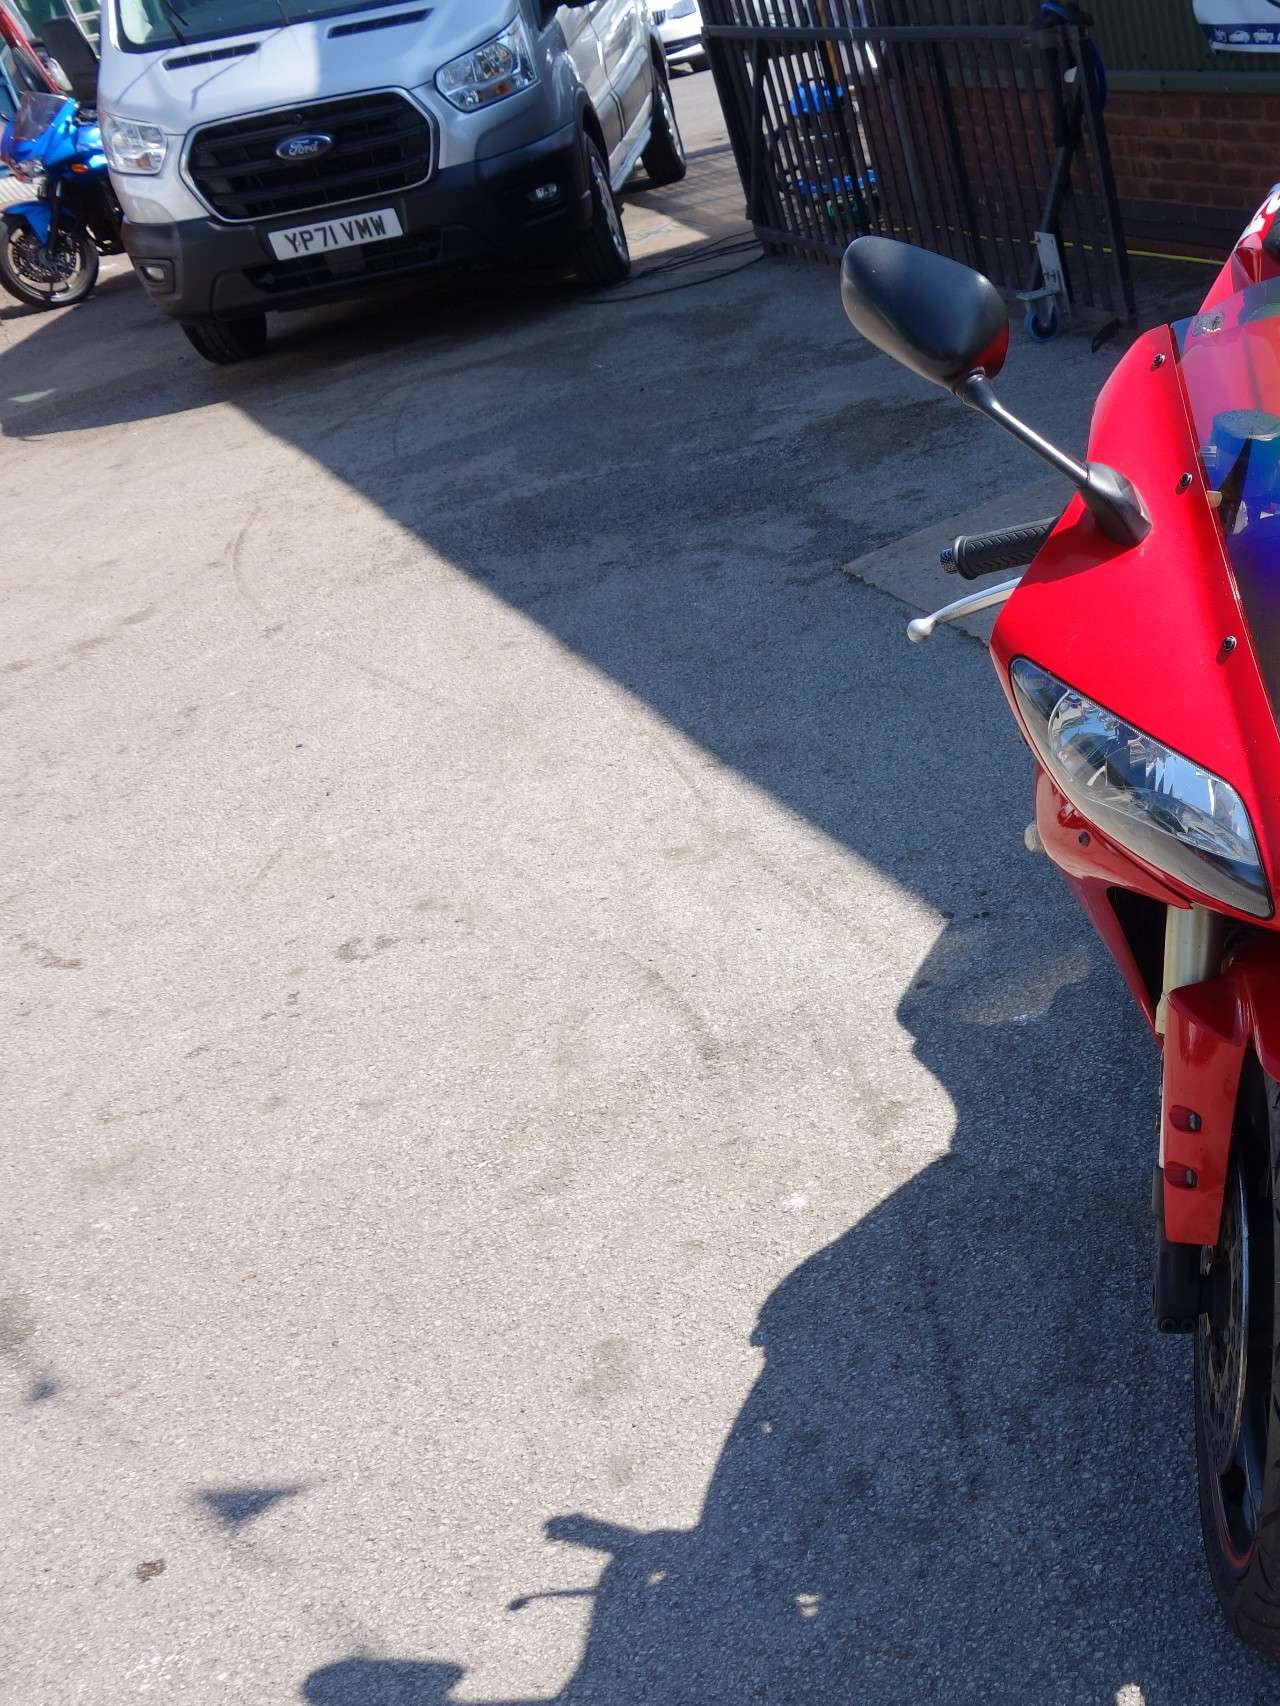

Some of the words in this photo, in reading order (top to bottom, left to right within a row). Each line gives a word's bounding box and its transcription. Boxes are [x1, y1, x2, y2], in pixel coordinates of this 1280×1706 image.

[288, 139, 319, 156] Ford
[284, 225, 338, 253] YP71
[339, 215, 387, 242] VMW
